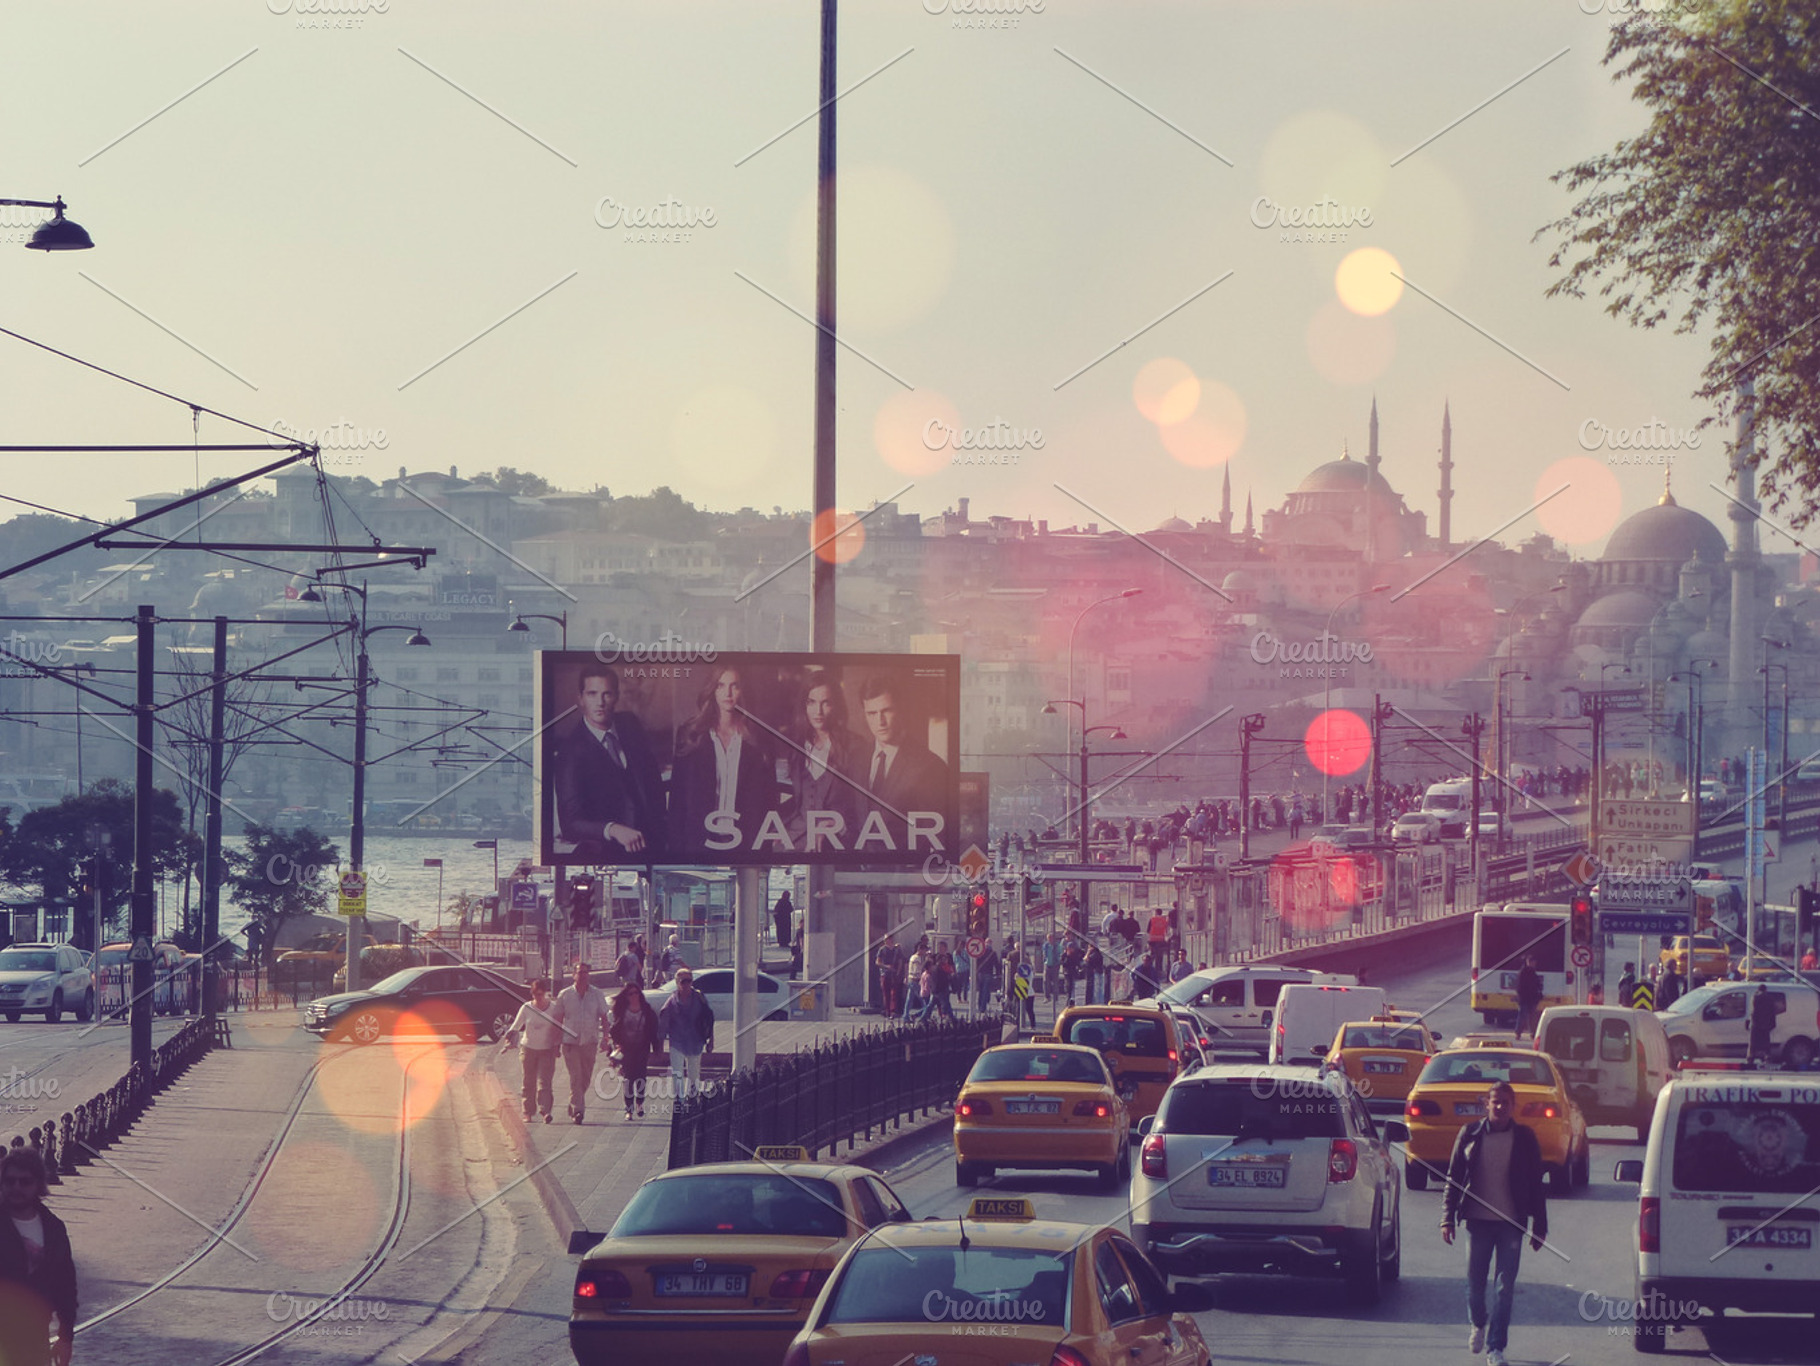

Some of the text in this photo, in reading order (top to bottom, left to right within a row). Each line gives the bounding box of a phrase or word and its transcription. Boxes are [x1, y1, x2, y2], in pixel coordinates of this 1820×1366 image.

[443, 592, 496, 604] LEGACY
[1618, 804, 1677, 816] Sirkeci
[704, 810, 946, 851] SARAR
[1618, 819, 1683, 831] Unkapanı
[1617, 842, 1658, 853] Fatih
[1602, 918, 1670, 930] Çevreyolu
[134, 946, 148, 957] 20
[1684, 1085, 1760, 1103] TRAFİK
[763, 1149, 799, 1159] TAKSI
[1217, 1170, 1280, 1182] 34 EL 8924
[977, 1201, 1023, 1214] TAKSI
[1754, 1229, 1766, 1244] A
[1770, 1229, 1809, 1244] 4334
[665, 1276, 682, 1291] 34
